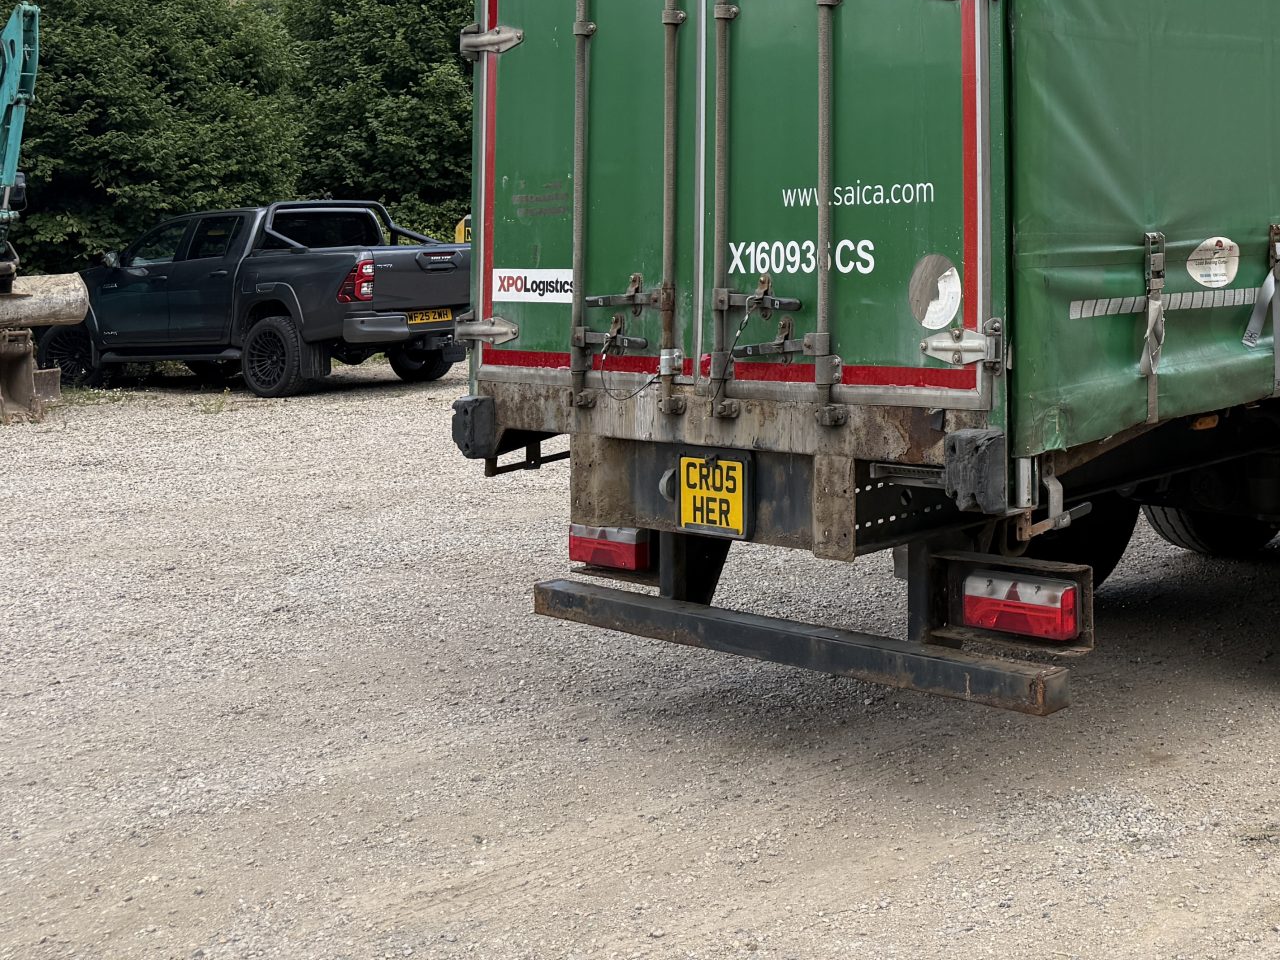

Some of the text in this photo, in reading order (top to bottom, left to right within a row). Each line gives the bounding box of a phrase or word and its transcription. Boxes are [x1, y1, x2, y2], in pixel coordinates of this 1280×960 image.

[782, 179, 935, 208] ww.saica.com
[686, 461, 737, 494] CR05
[693, 495, 731, 527] HER
